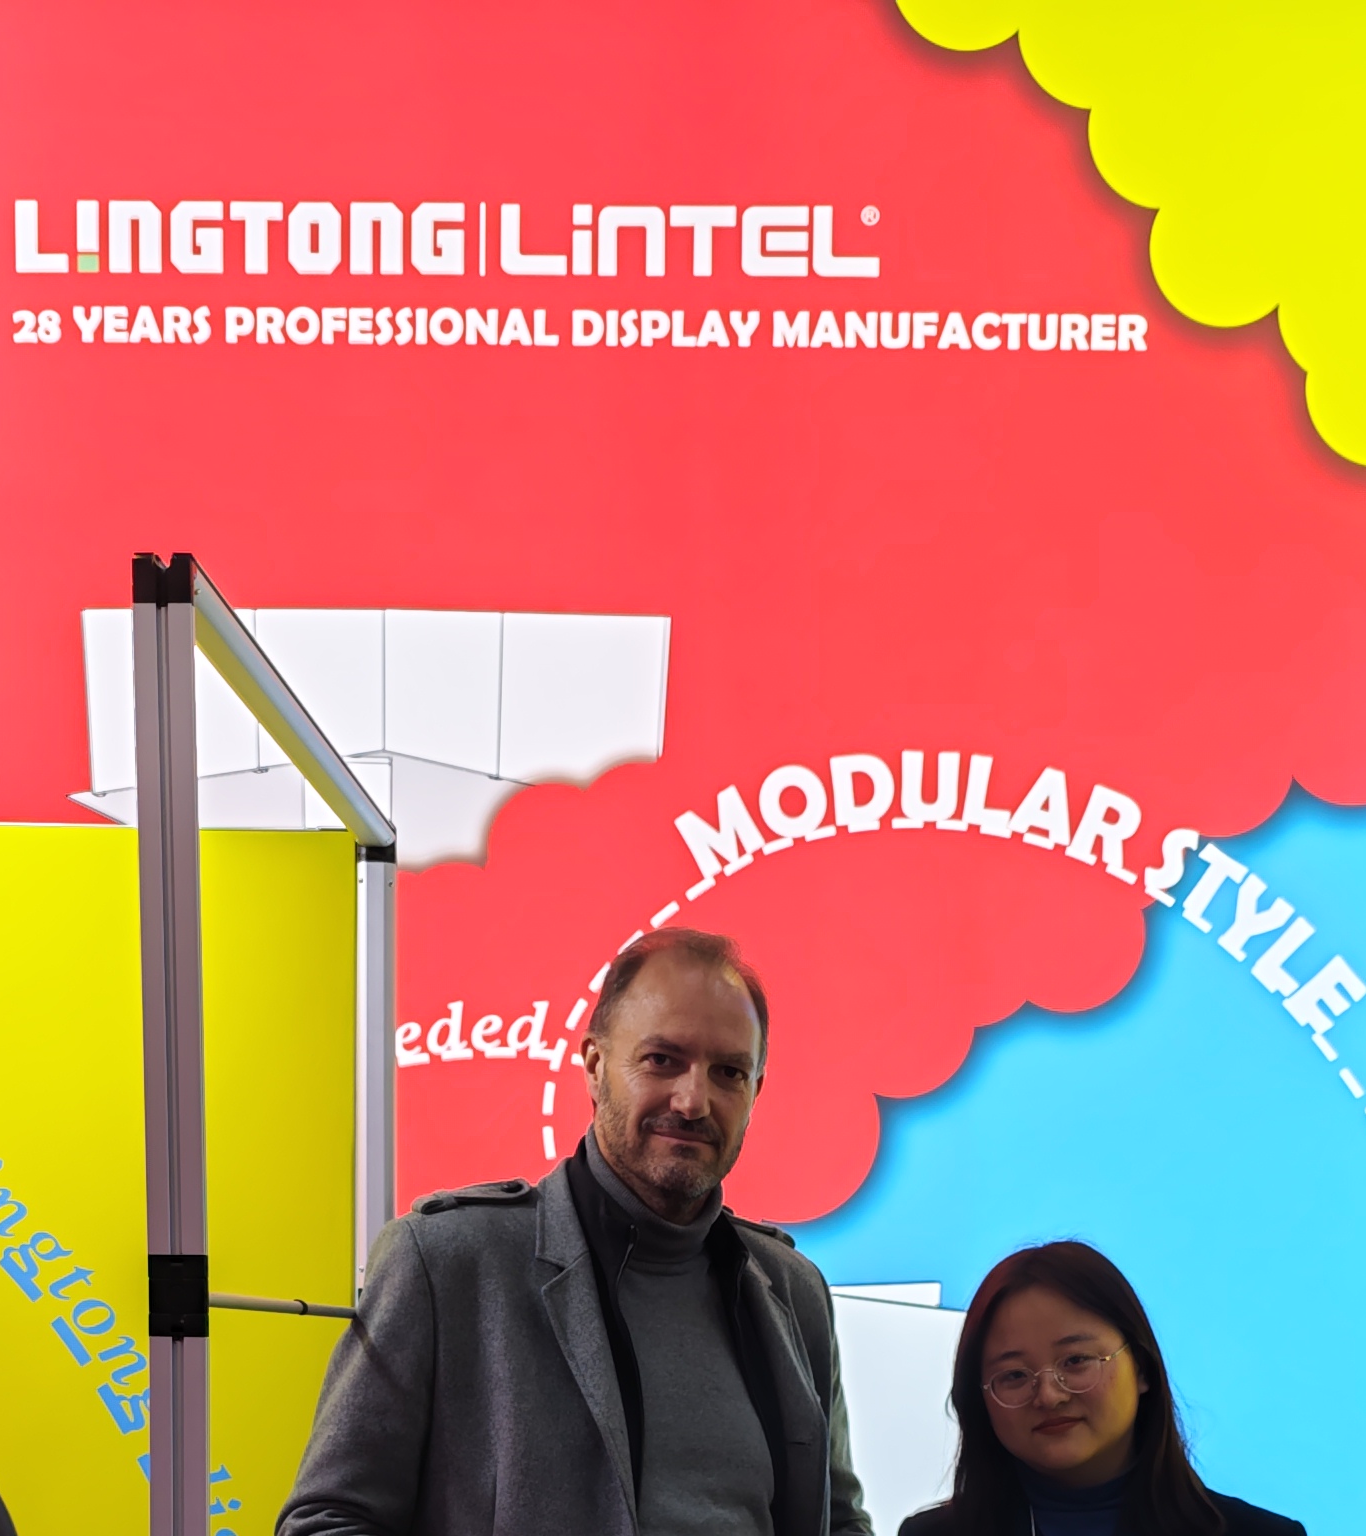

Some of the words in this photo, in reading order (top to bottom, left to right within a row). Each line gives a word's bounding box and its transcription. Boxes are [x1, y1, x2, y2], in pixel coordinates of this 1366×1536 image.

[11, 308, 62, 346] 28
[72, 303, 212, 346] YEARS
[225, 305, 560, 348] PROFESSIONAL
[570, 308, 761, 350] DISPLAY
[770, 309, 1150, 353] MANUFACTURER
[673, 749, 1142, 884] MODULAR
[395, 999, 550, 1057] eded
